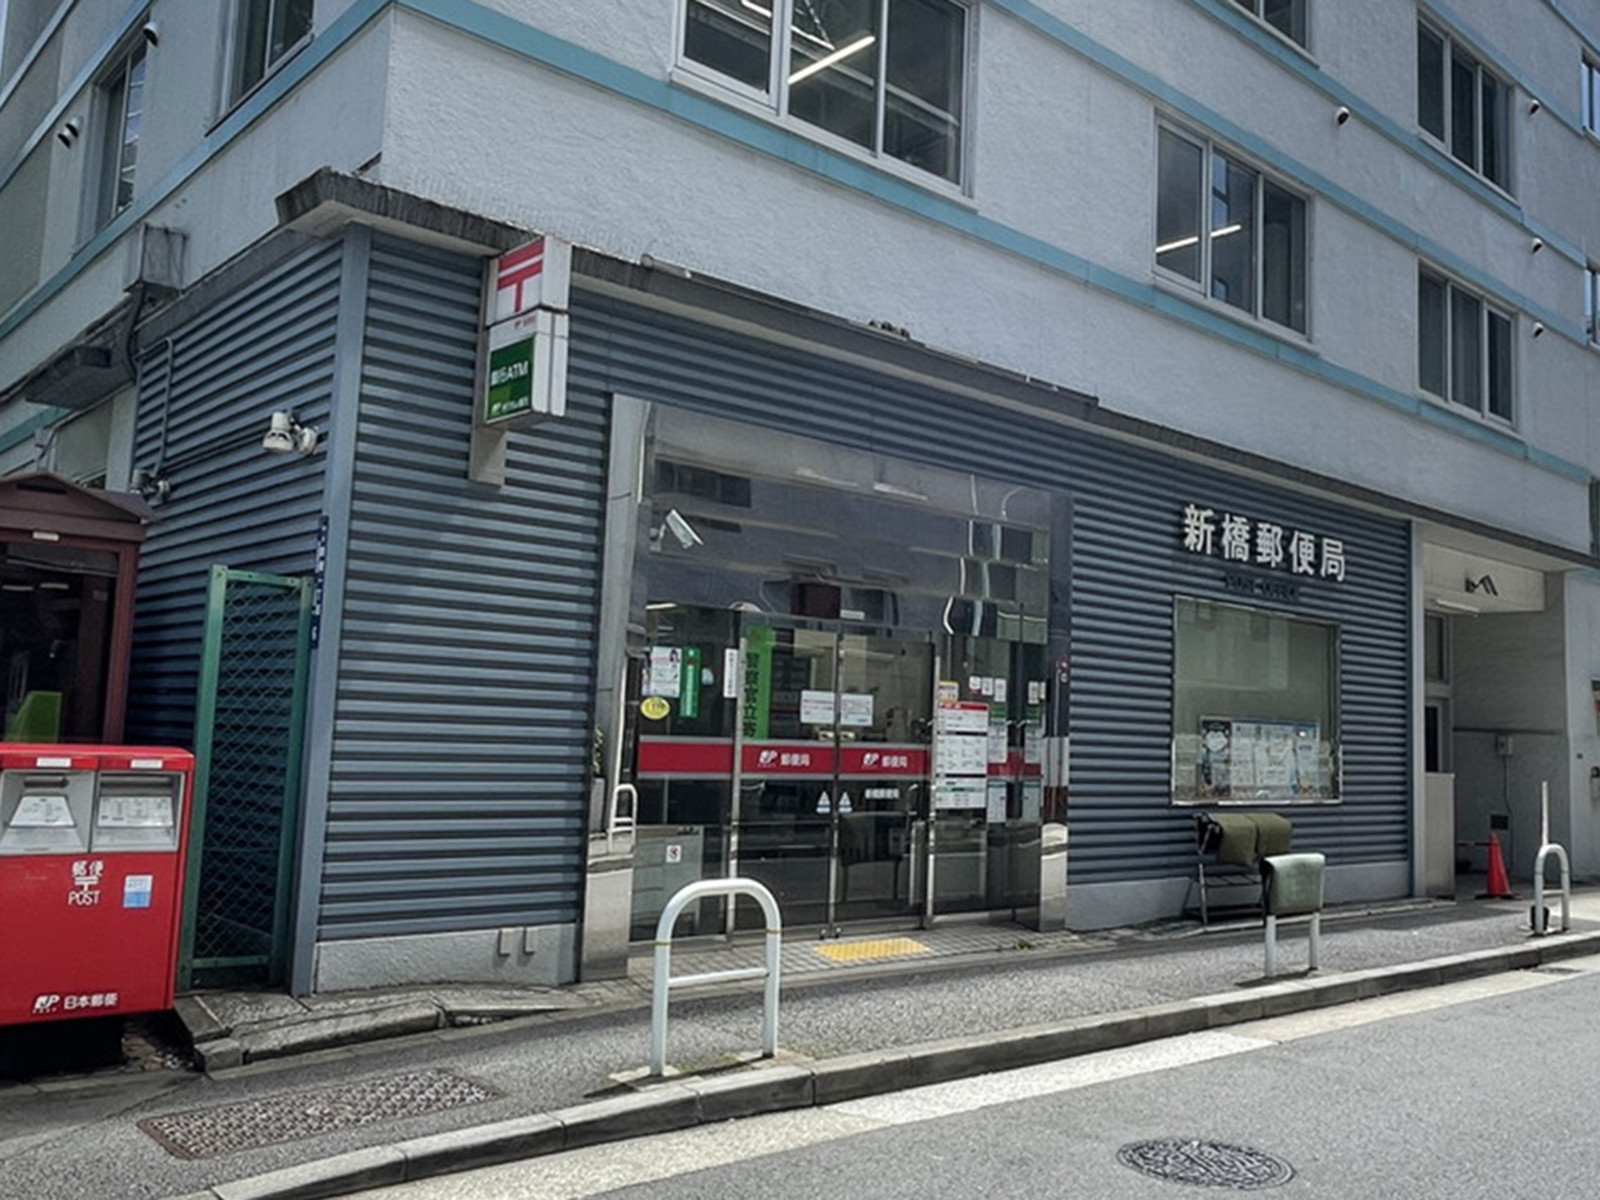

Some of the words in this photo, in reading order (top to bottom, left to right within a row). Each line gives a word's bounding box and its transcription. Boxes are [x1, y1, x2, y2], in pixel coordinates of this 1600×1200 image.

[1184, 504, 1346, 582] 新橋郵便局
[72, 860, 104, 877] 郵便
[68, 891, 101, 906] POST
[63, 992, 118, 1010] 日本郵便
